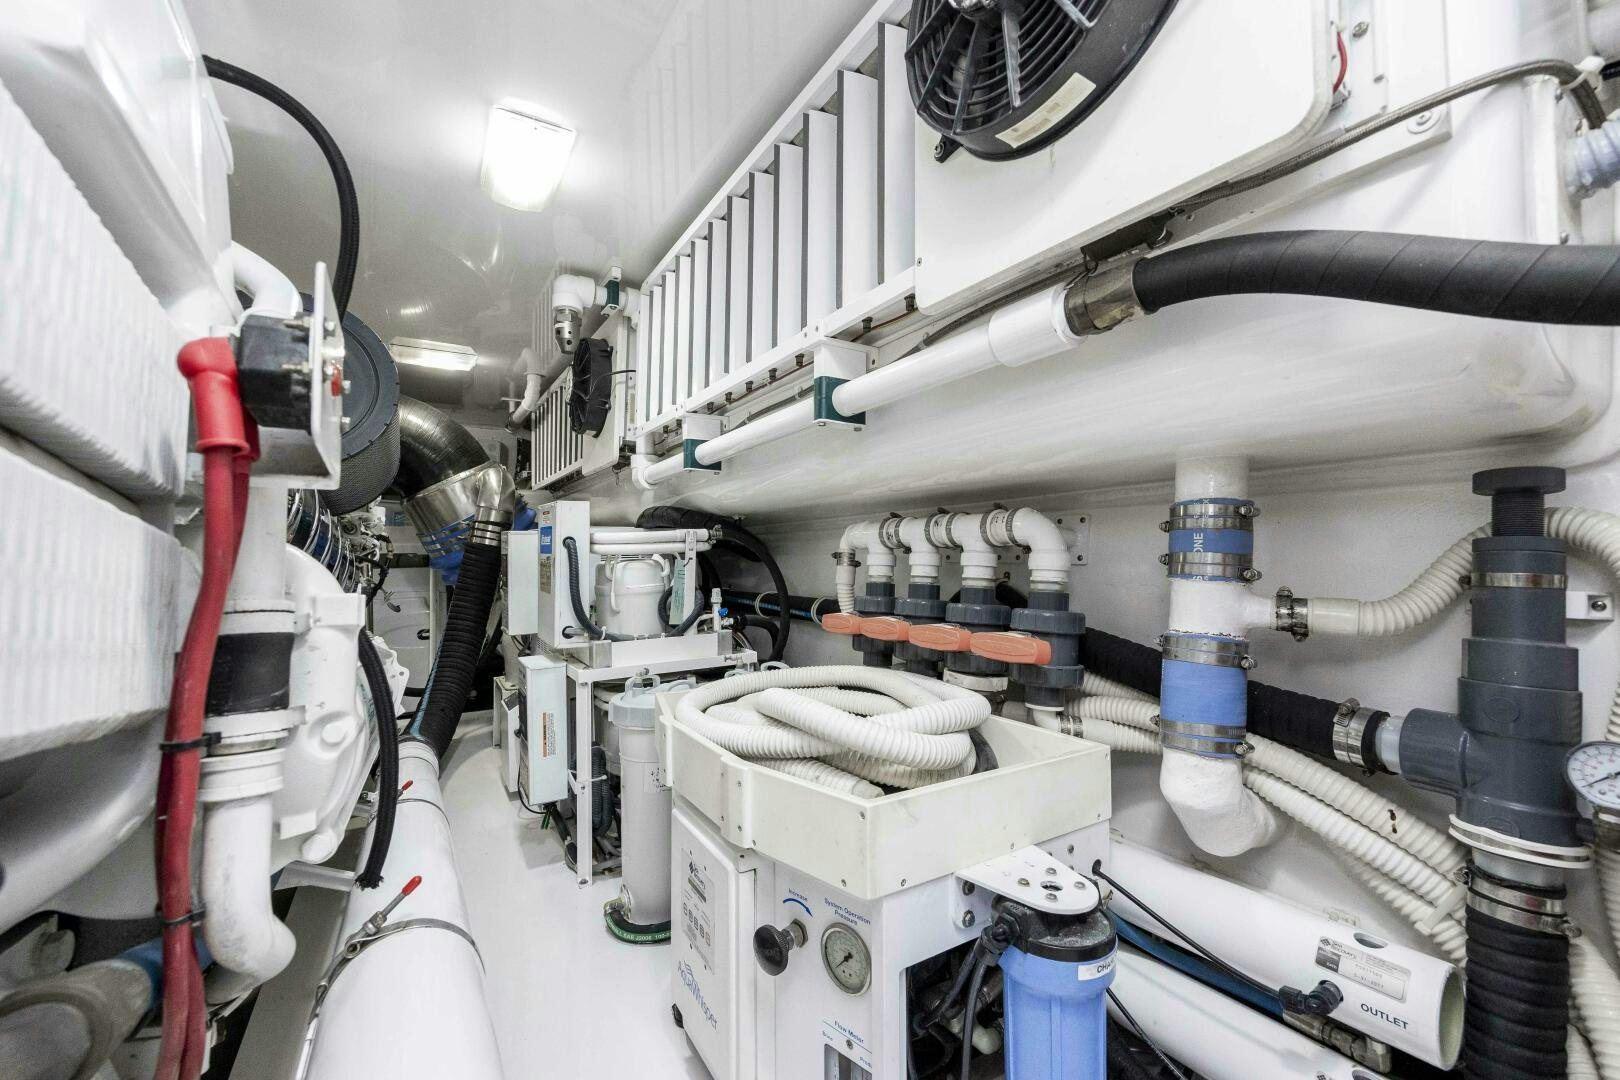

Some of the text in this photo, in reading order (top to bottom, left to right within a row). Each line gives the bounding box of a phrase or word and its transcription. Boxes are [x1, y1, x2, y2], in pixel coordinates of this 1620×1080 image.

[788, 888, 808, 902] Increase
[824, 897, 871, 925] System Operation
[834, 909, 858, 926] Pressure
[1360, 1003, 1409, 1030] OUTLET
[834, 1020, 847, 1033] Flow
